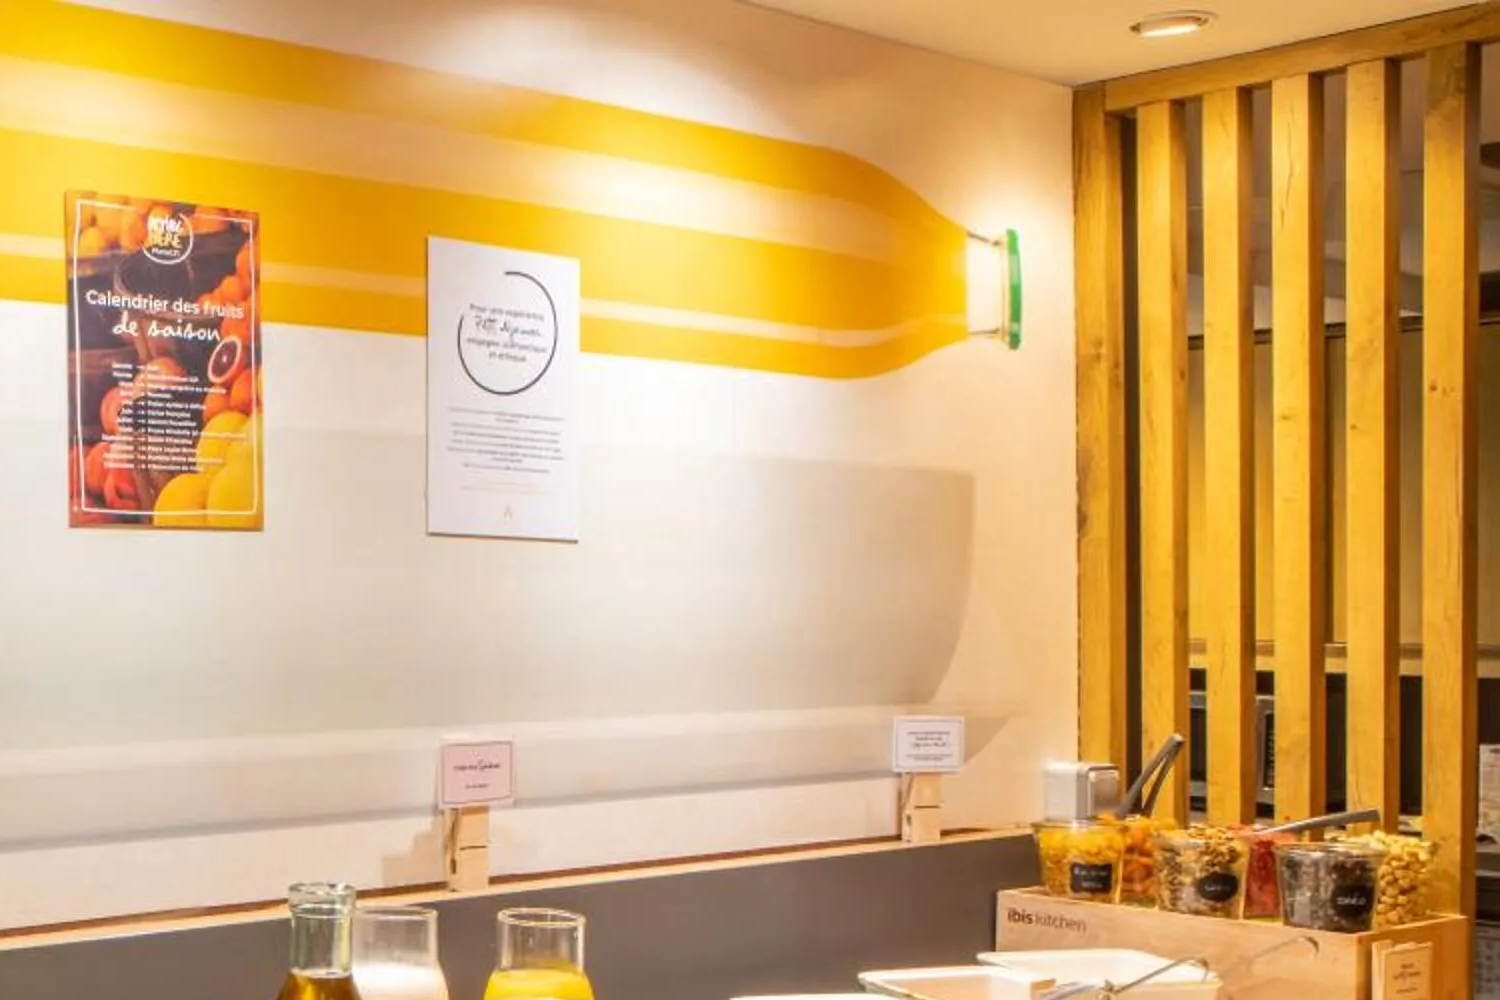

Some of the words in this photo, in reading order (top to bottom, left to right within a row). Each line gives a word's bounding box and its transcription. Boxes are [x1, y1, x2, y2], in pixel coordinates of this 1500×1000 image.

[85, 289, 168, 313] Calendrier
[172, 297, 200, 315] des
[203, 301, 245, 319] fruits
[112, 310, 139, 337] de
[147, 318, 221, 342] saison
[1007, 907, 1033, 925] ibis
[1035, 911, 1087, 934] kitchen
